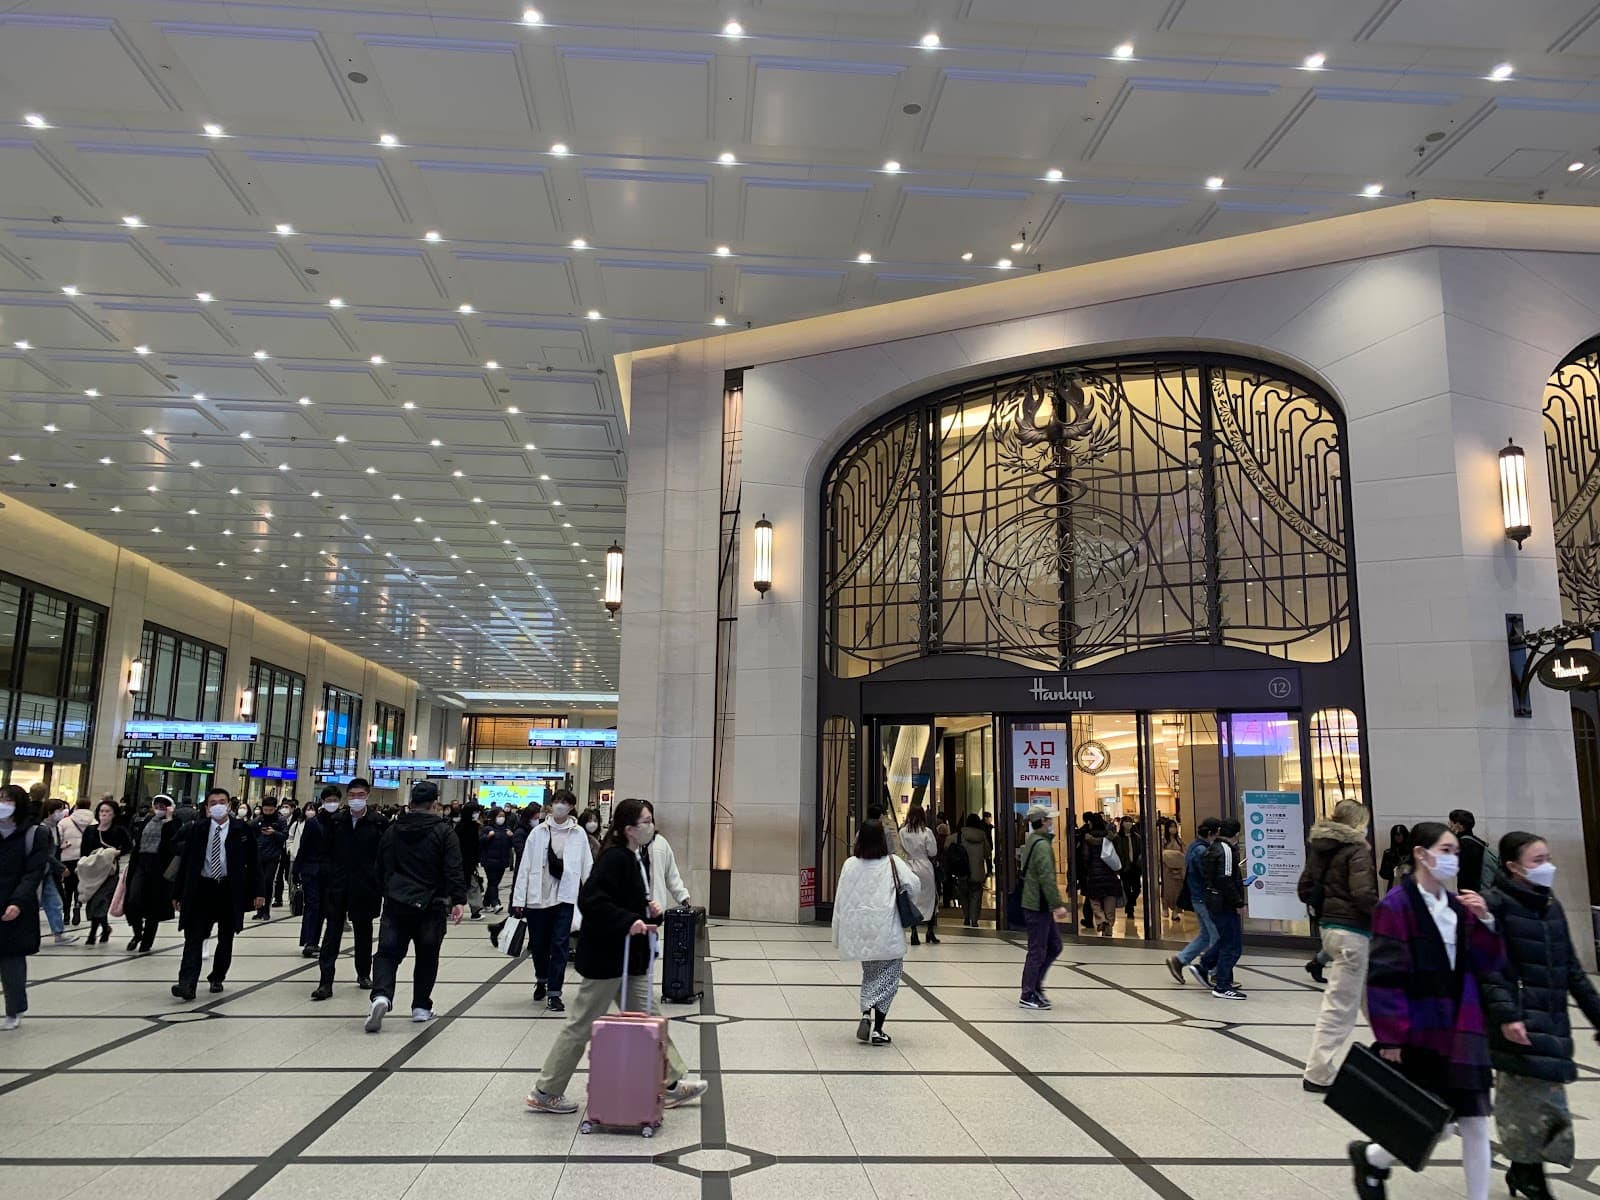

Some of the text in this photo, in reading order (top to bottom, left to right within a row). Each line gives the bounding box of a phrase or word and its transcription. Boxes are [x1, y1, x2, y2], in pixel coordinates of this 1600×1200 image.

[1552, 657, 1590, 681] Hankyu
[1028, 676, 1096, 708] Hankyu
[1272, 682, 1287, 694] 12
[15, 746, 54, 758] COLOR FIELD
[1023, 740, 1055, 756] 入口
[1028, 758, 1051, 769] 専用
[1020, 774, 1061, 782] ENTRANCE
